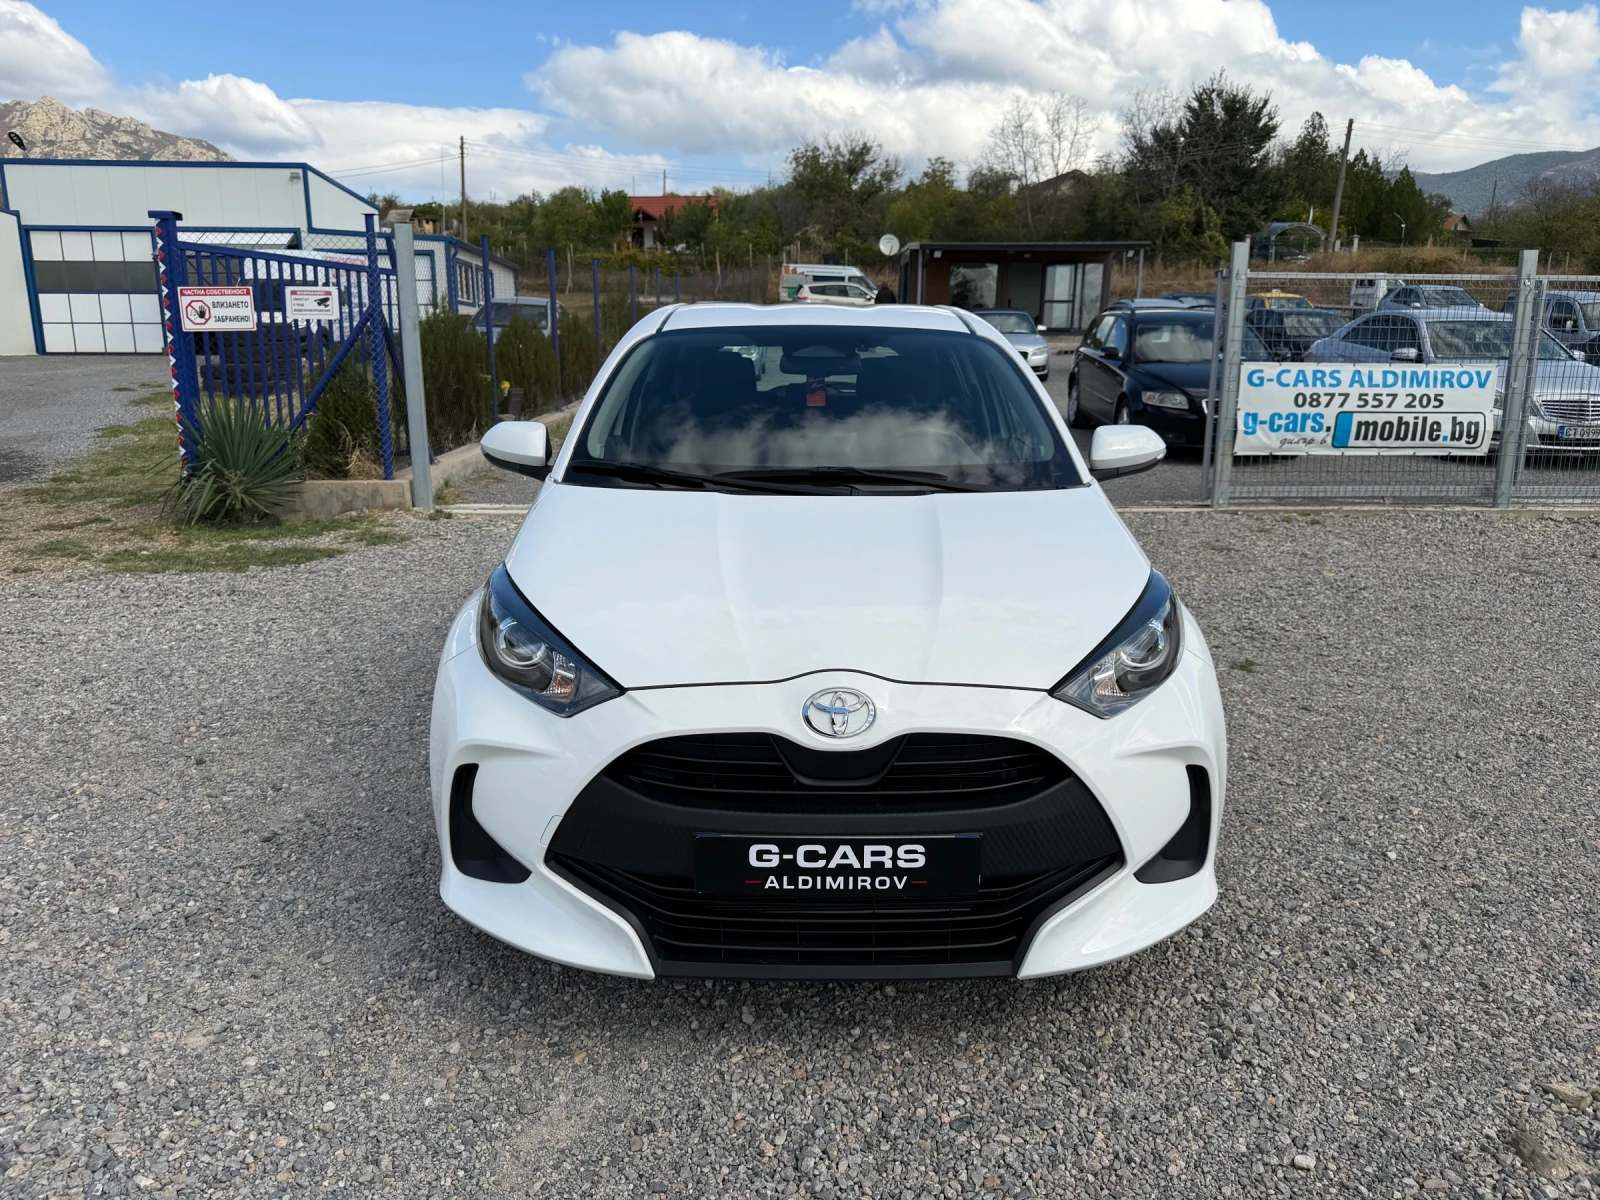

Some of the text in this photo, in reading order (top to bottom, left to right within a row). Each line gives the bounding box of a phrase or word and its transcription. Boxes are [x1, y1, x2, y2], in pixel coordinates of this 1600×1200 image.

[211, 301, 249, 309] ВЛИЗАНЕТО
[213, 315, 251, 323] ЗАБРАНЕНО!
[1246, 369, 1492, 389] G-CARS ALDIMIROV
[1293, 392, 1444, 409] 0877 557 205
[1354, 416, 1480, 445] mobile.bg
[748, 844, 926, 869] G-CARS
[764, 875, 908, 890] ALDIMIROV
